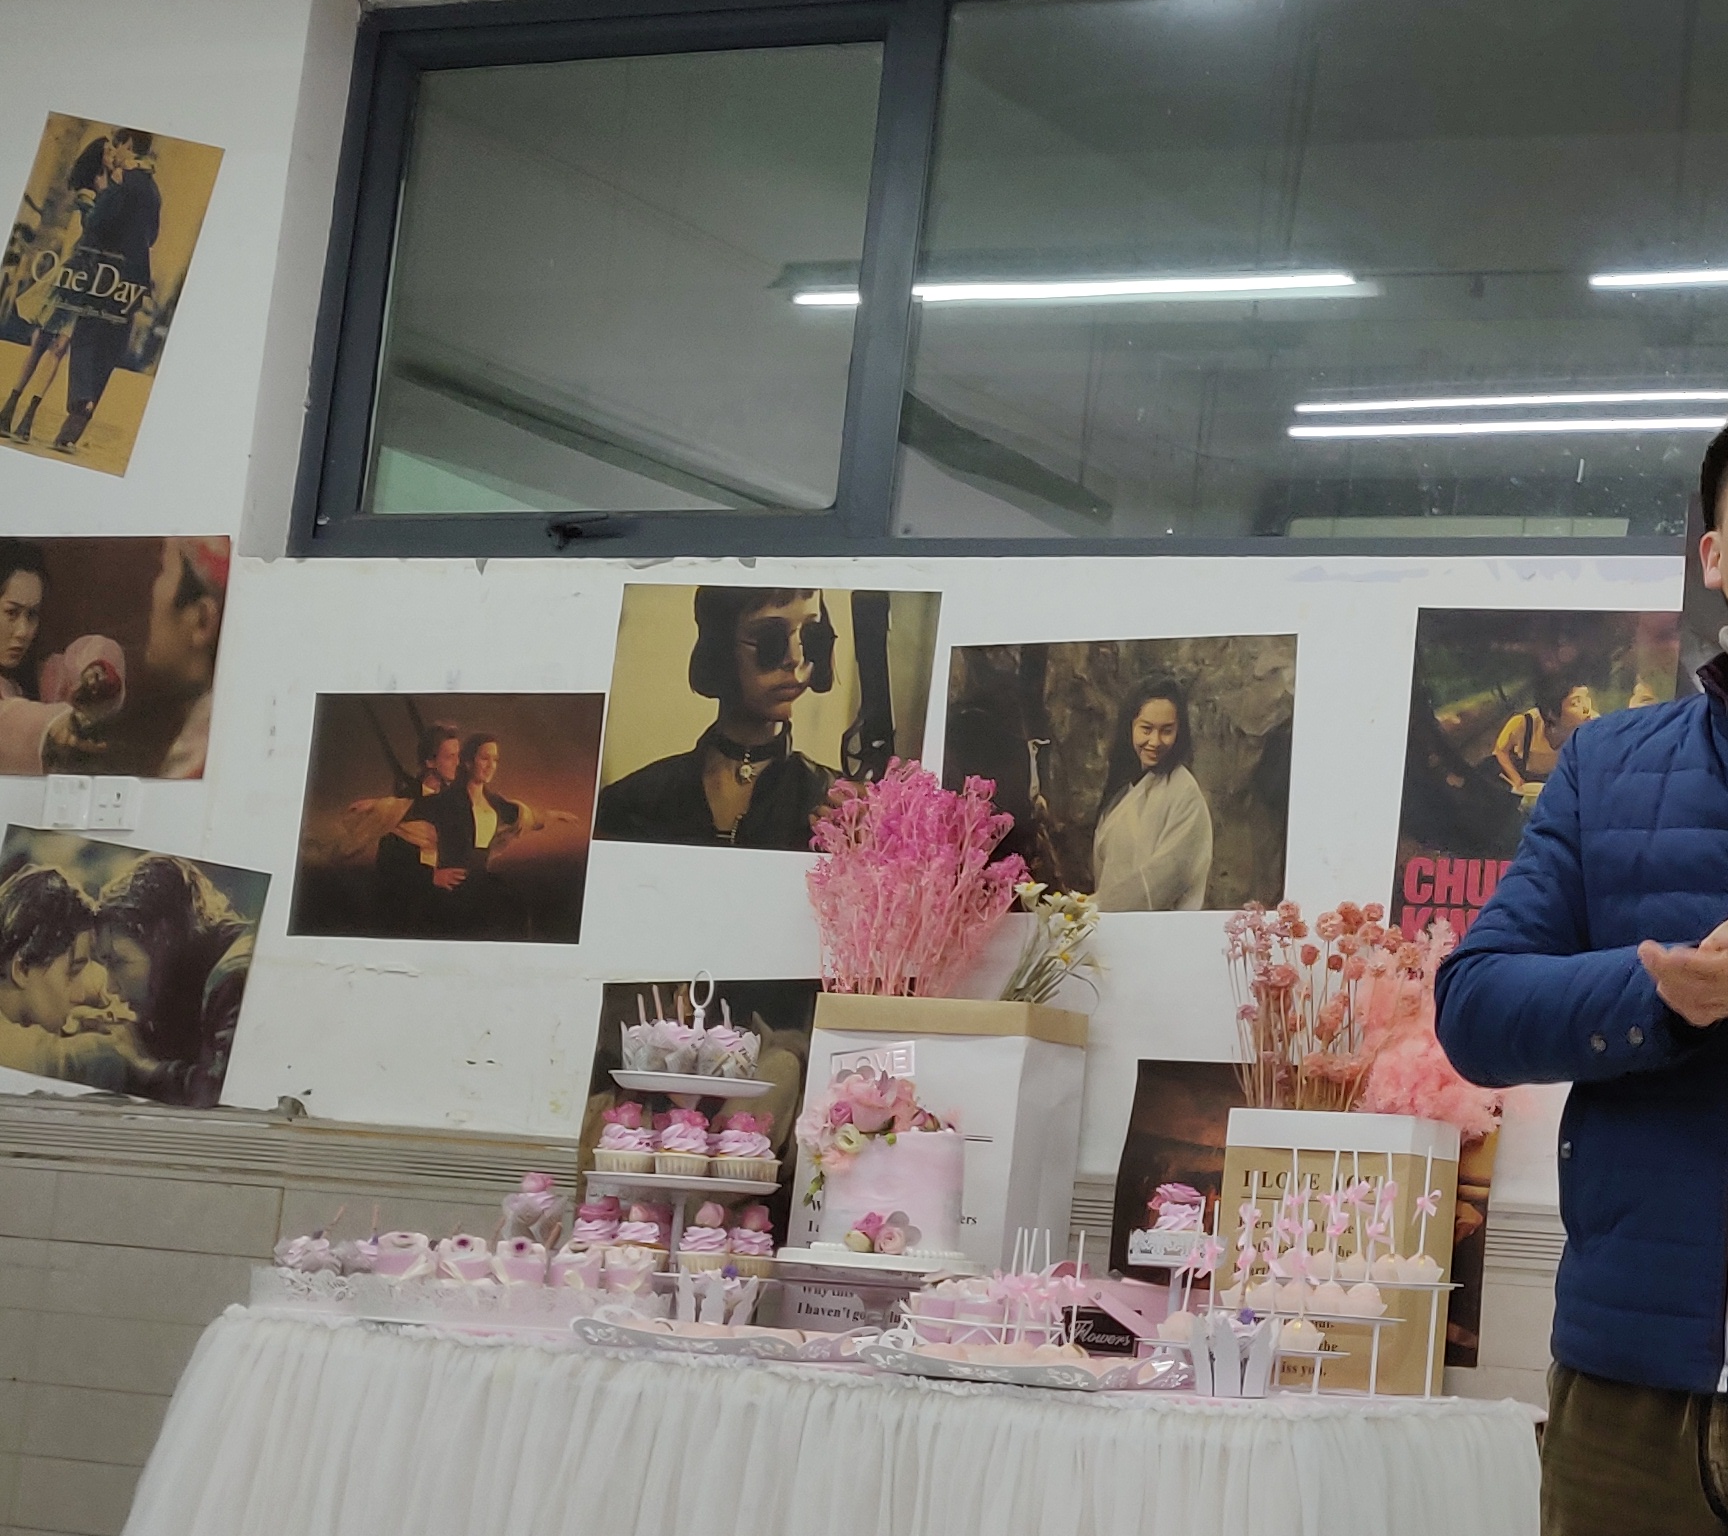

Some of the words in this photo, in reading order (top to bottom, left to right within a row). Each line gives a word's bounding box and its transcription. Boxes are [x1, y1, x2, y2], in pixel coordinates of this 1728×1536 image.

[32, 250, 88, 292] One
[86, 263, 148, 314] Day
[805, 1303, 851, 1319] haven't
[1068, 1320, 1131, 1346] Flowers
